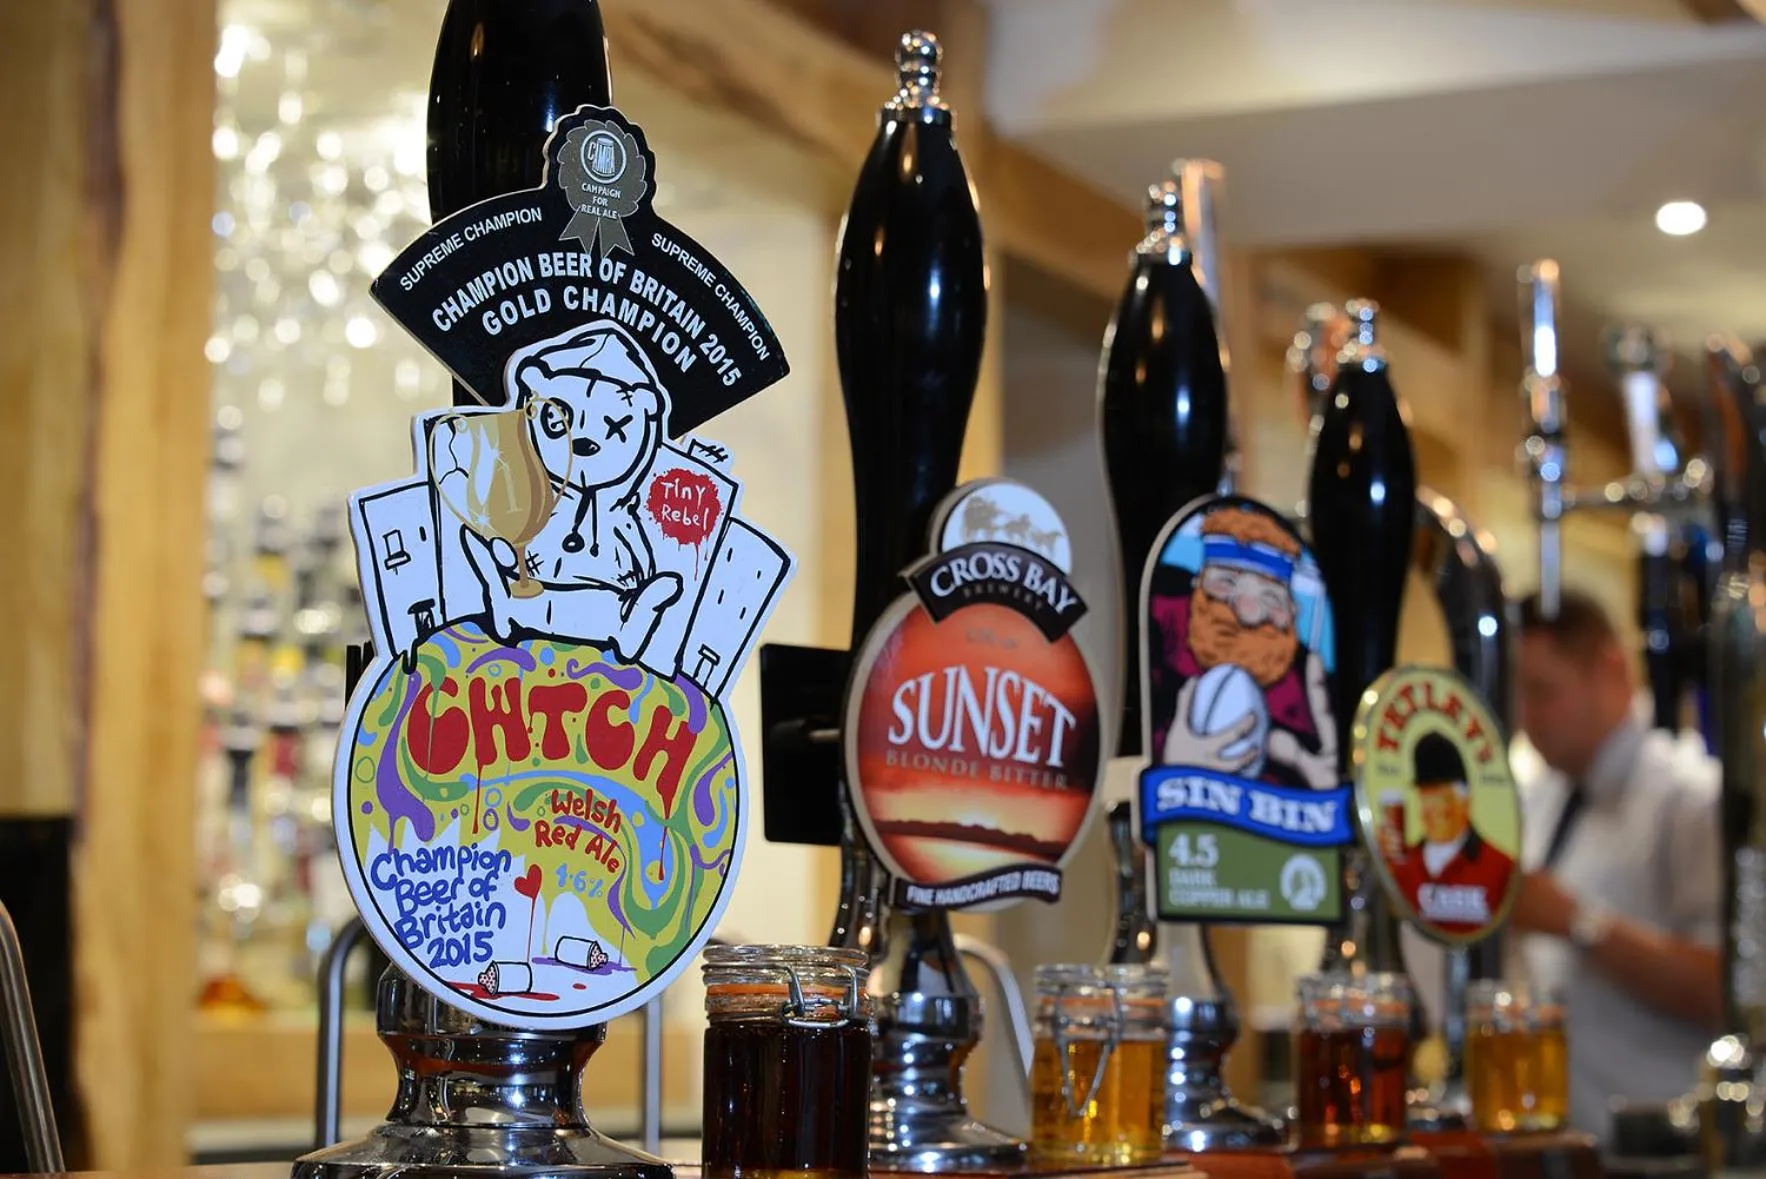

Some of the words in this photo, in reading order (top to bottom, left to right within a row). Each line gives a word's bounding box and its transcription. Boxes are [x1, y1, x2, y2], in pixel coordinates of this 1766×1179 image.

[581, 182, 621, 199] CAMPAIGN
[581, 204, 601, 216] REAL
[602, 209, 618, 219] ALE
[592, 196, 608, 206] FOR
[400, 234, 462, 291] SUPREME
[464, 207, 542, 241] CHAMPION
[432, 257, 534, 331] CHAMPION
[538, 252, 592, 277] BEER
[599, 258, 626, 283] OF
[630, 270, 704, 340] BRITAIN
[698, 333, 743, 386] 2015
[651, 233, 716, 288] SUPREME
[714, 283, 769, 361] CHAMPION
[482, 289, 551, 335] GOLD
[564, 286, 697, 373] CHAMPION
[661, 478, 705, 509] Tiny
[662, 504, 709, 531] Rebel
[930, 552, 1022, 597] CROSS
[1023, 562, 1077, 615] BAY
[407, 677, 697, 791] CWTCH
[888, 666, 1075, 767] SUNSET
[885, 748, 979, 778] BLONDE
[989, 764, 1068, 791] BITTER
[551, 788, 621, 834] Welsh
[1157, 777, 1242, 816] SIN
[1247, 790, 1337, 833] BIN
[371, 843, 511, 890] Champion
[535, 819, 582, 851] Red
[585, 833, 620, 873] Ale
[1168, 833, 1219, 868] 4.5
[395, 874, 464, 914] Beer
[469, 872, 500, 902] of
[395, 903, 506, 949] Britain
[427, 931, 494, 969] 2015
